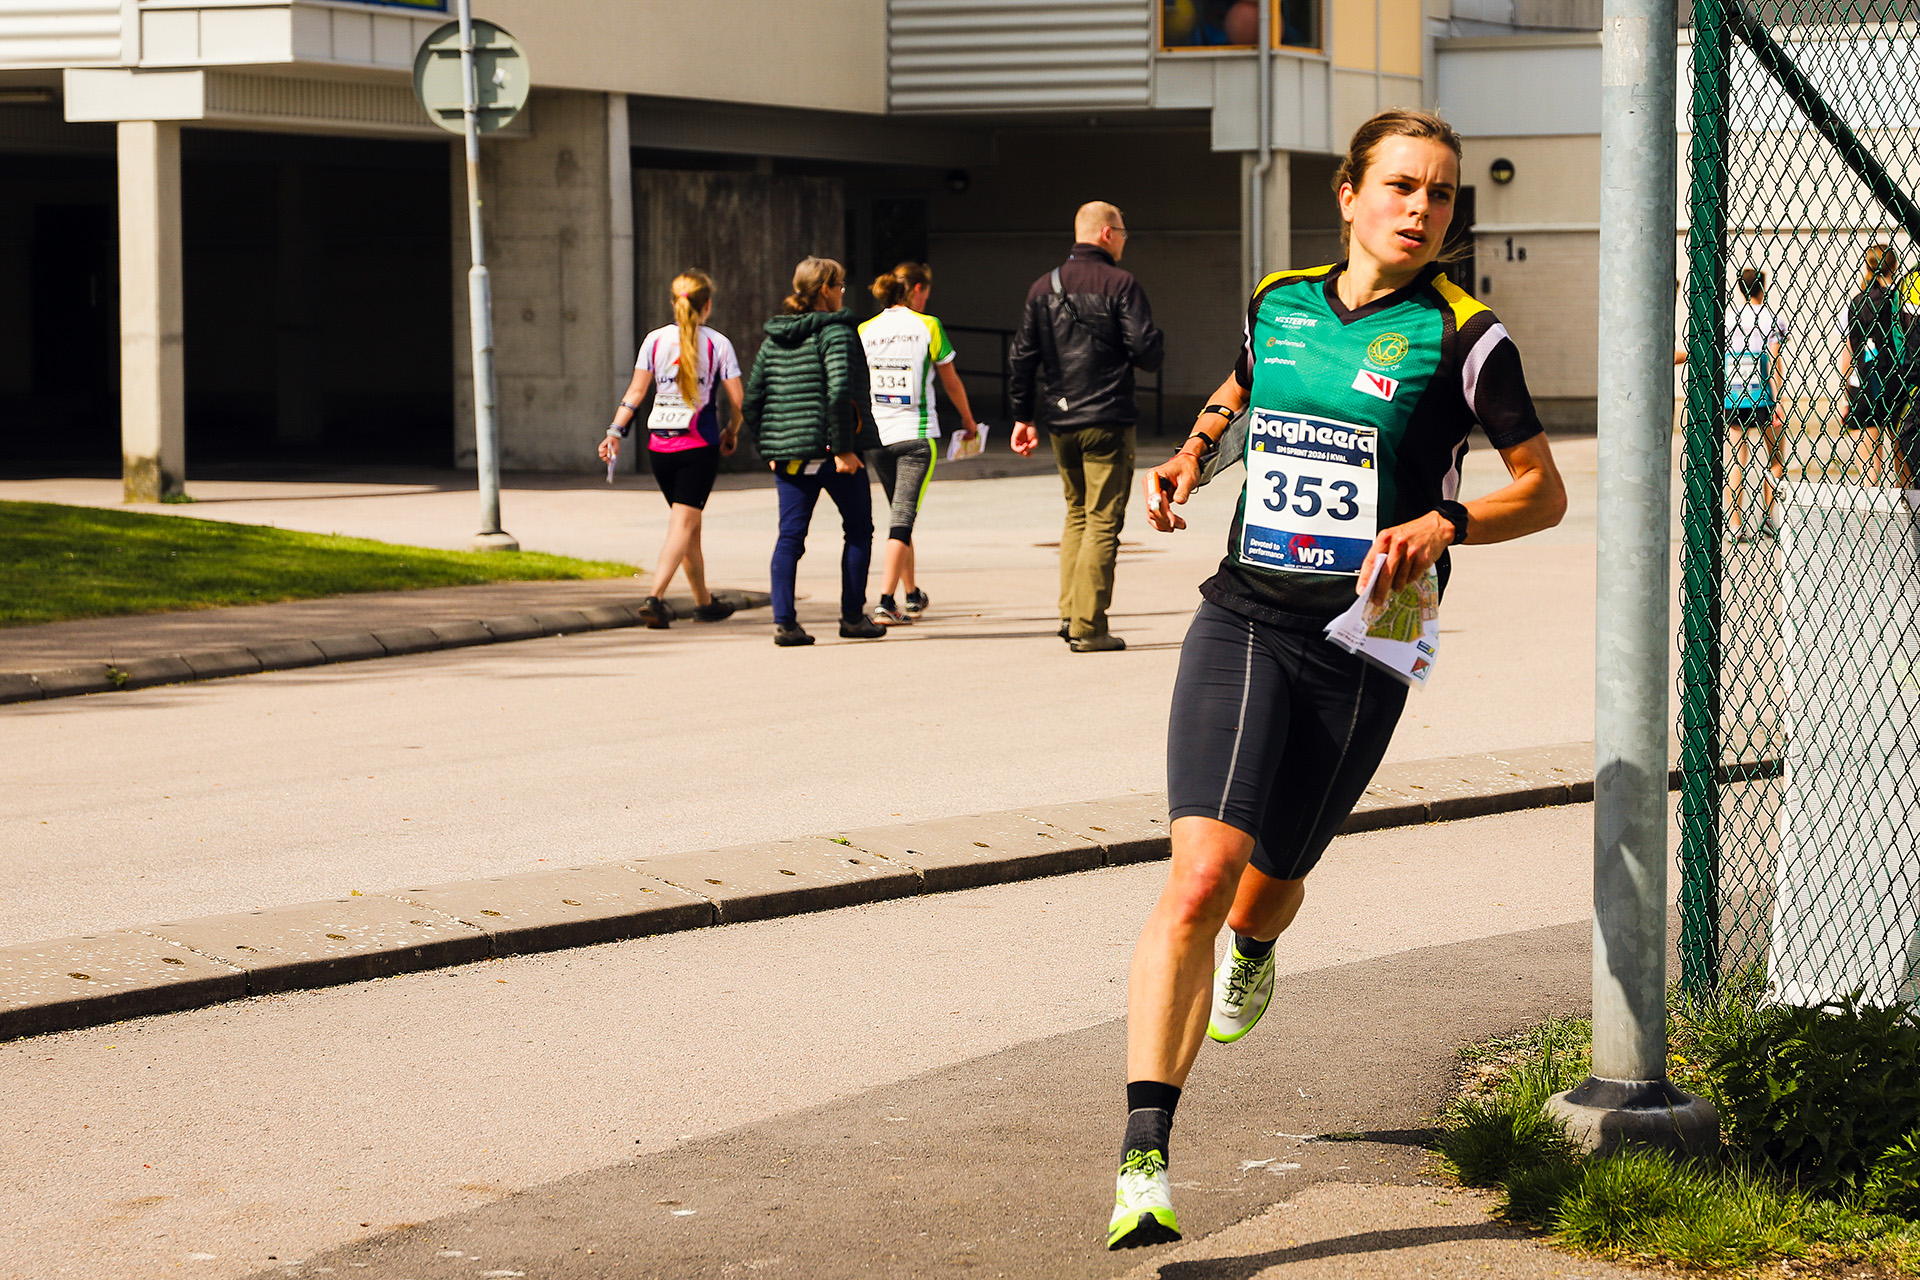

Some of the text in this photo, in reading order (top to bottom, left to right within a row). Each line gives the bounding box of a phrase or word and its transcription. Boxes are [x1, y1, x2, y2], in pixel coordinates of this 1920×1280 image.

[877, 375, 907, 388] 334
[656, 411, 687, 423] 307
[1252, 415, 1374, 454] bagheera
[1276, 445, 1287, 454] SM
[1286, 447, 1309, 457] SPRINT
[1307, 450, 1326, 460] 2026
[1330, 453, 1348, 462] KVAL
[1263, 470, 1359, 521] 353
[1250, 538, 1281, 551] Devoted to
[1248, 547, 1285, 560] performance
[1297, 546, 1335, 567] WJS
